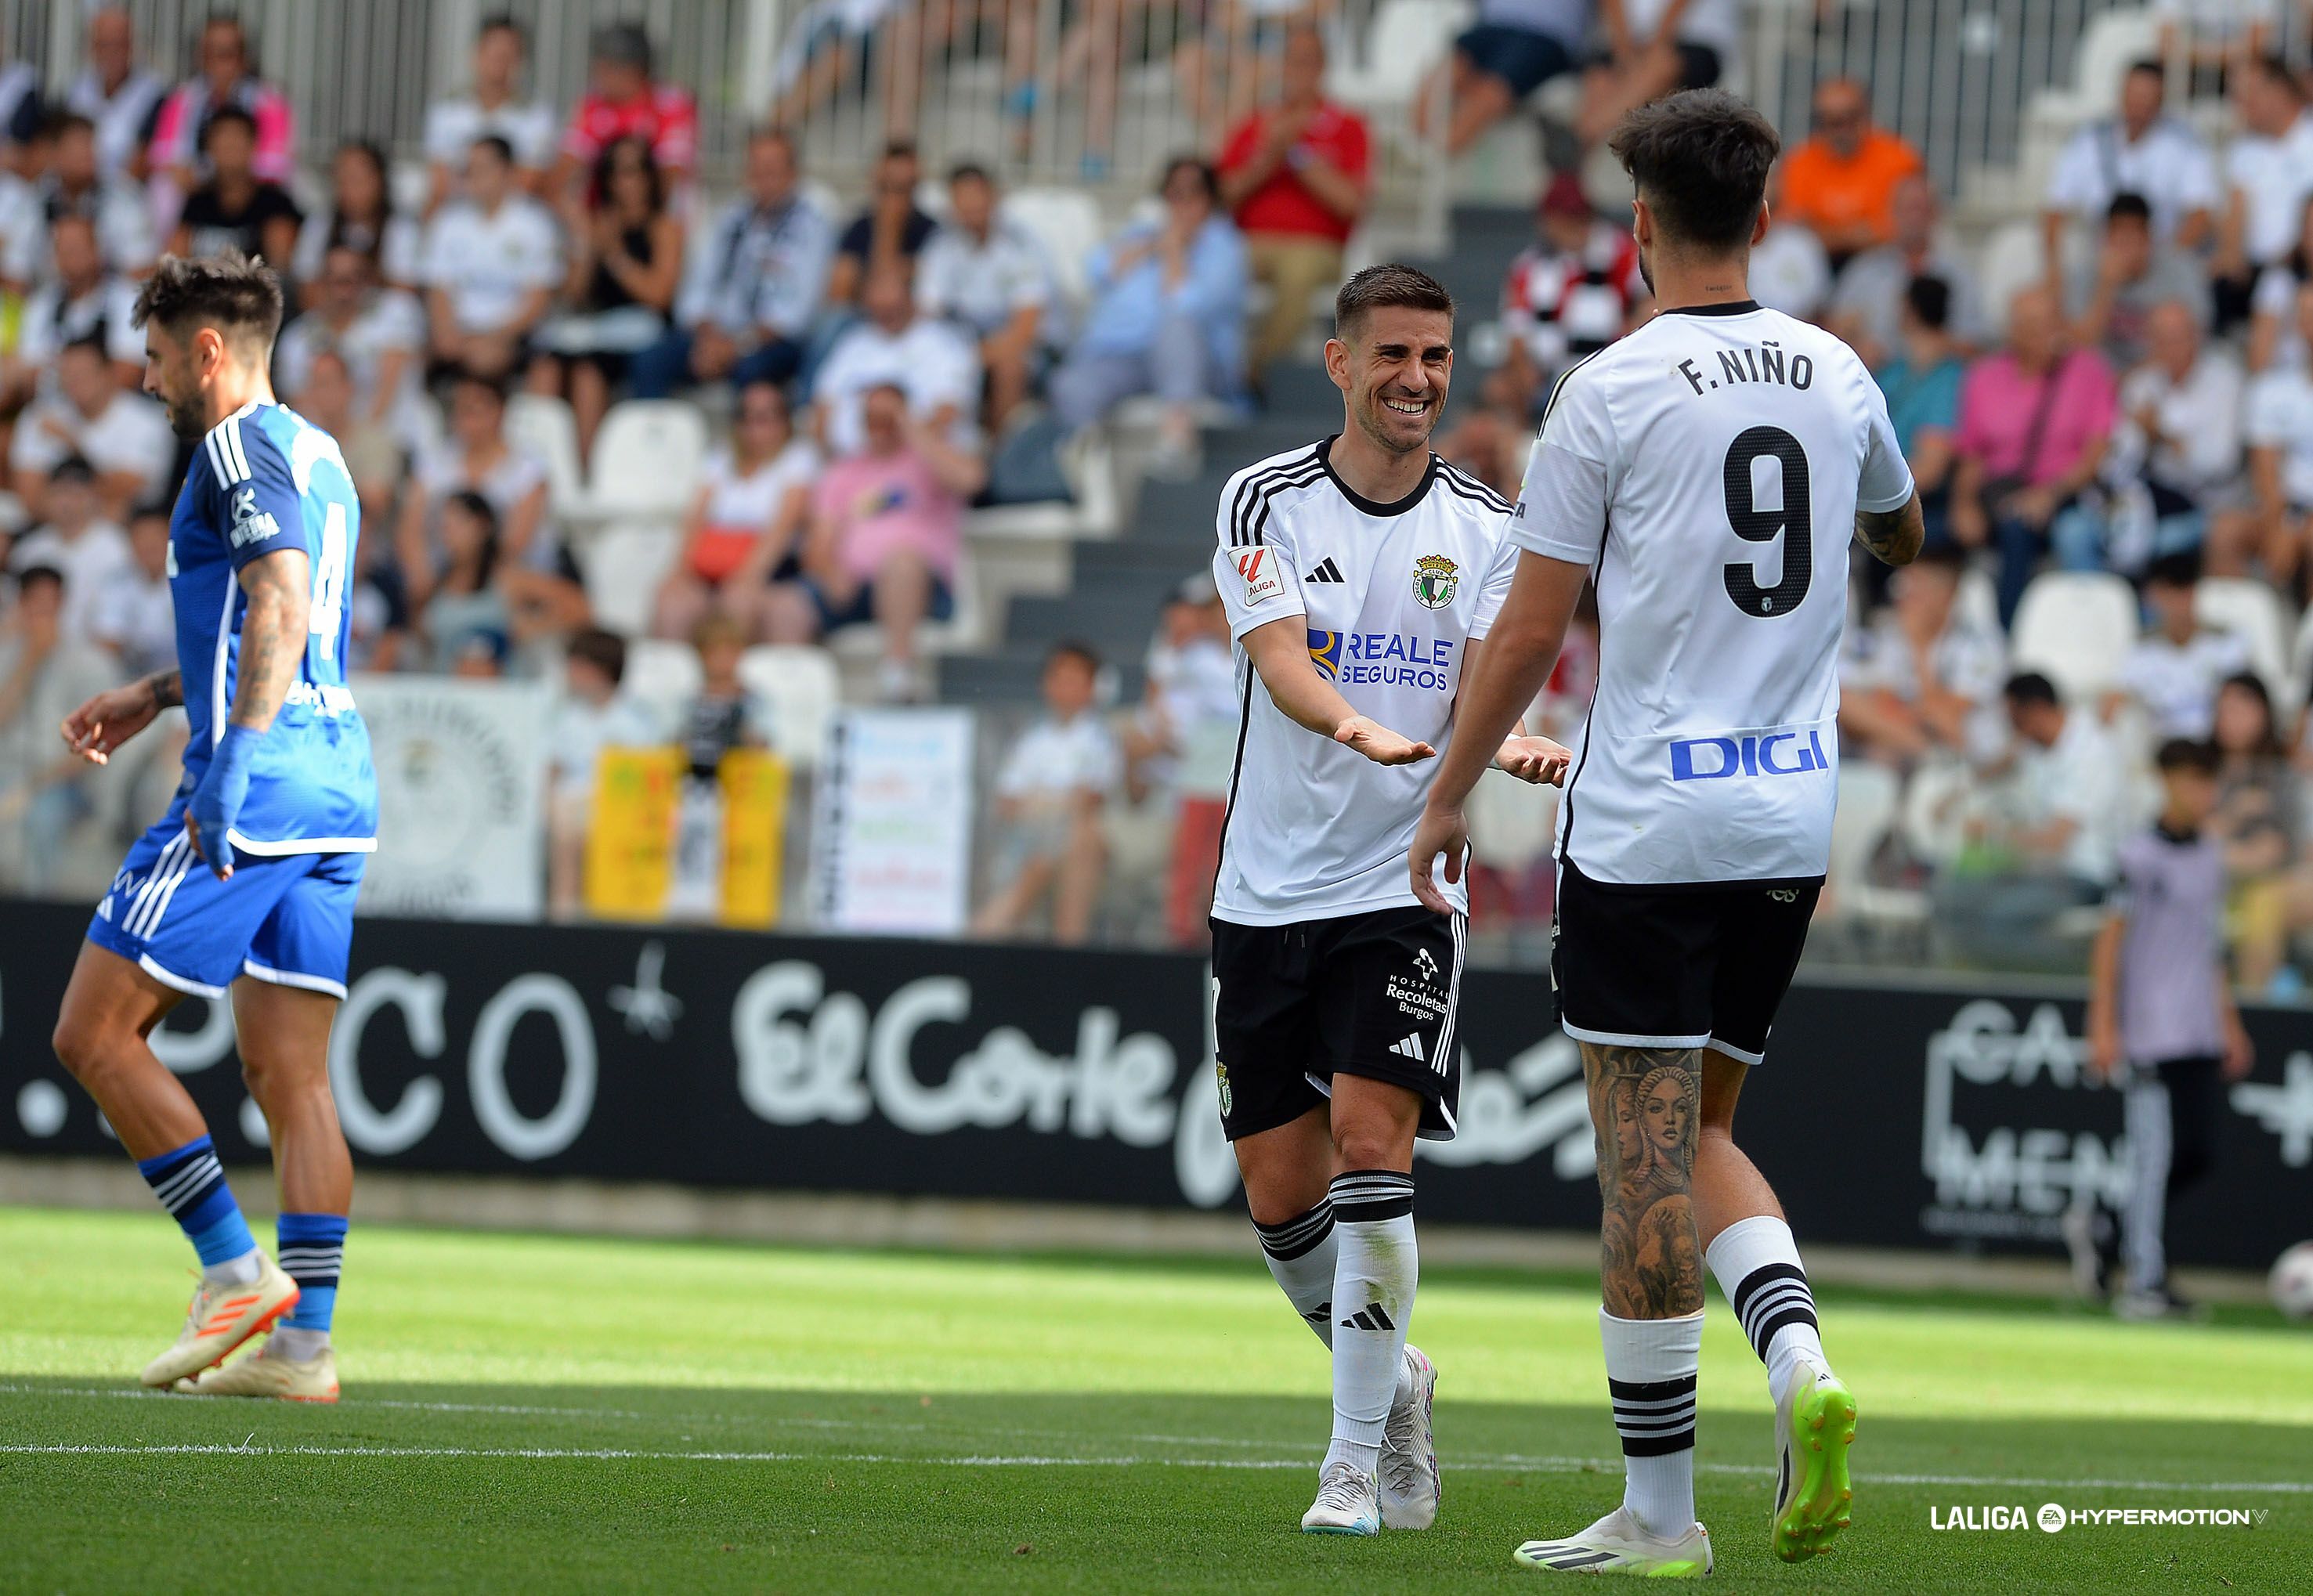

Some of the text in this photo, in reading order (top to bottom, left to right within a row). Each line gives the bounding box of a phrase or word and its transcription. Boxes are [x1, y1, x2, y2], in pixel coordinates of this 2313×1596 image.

[1723, 425, 1812, 618] 9
[309, 501, 347, 661] 4
[1346, 633, 1454, 668] REALE
[1342, 665, 1447, 691] SEGUROS
[1670, 731, 1829, 782] DIGI
[1386, 984, 1447, 1014] Recoletas
[1390, 974, 1449, 999] HOSPITAL
[1399, 1002, 1434, 1020] Burgos
